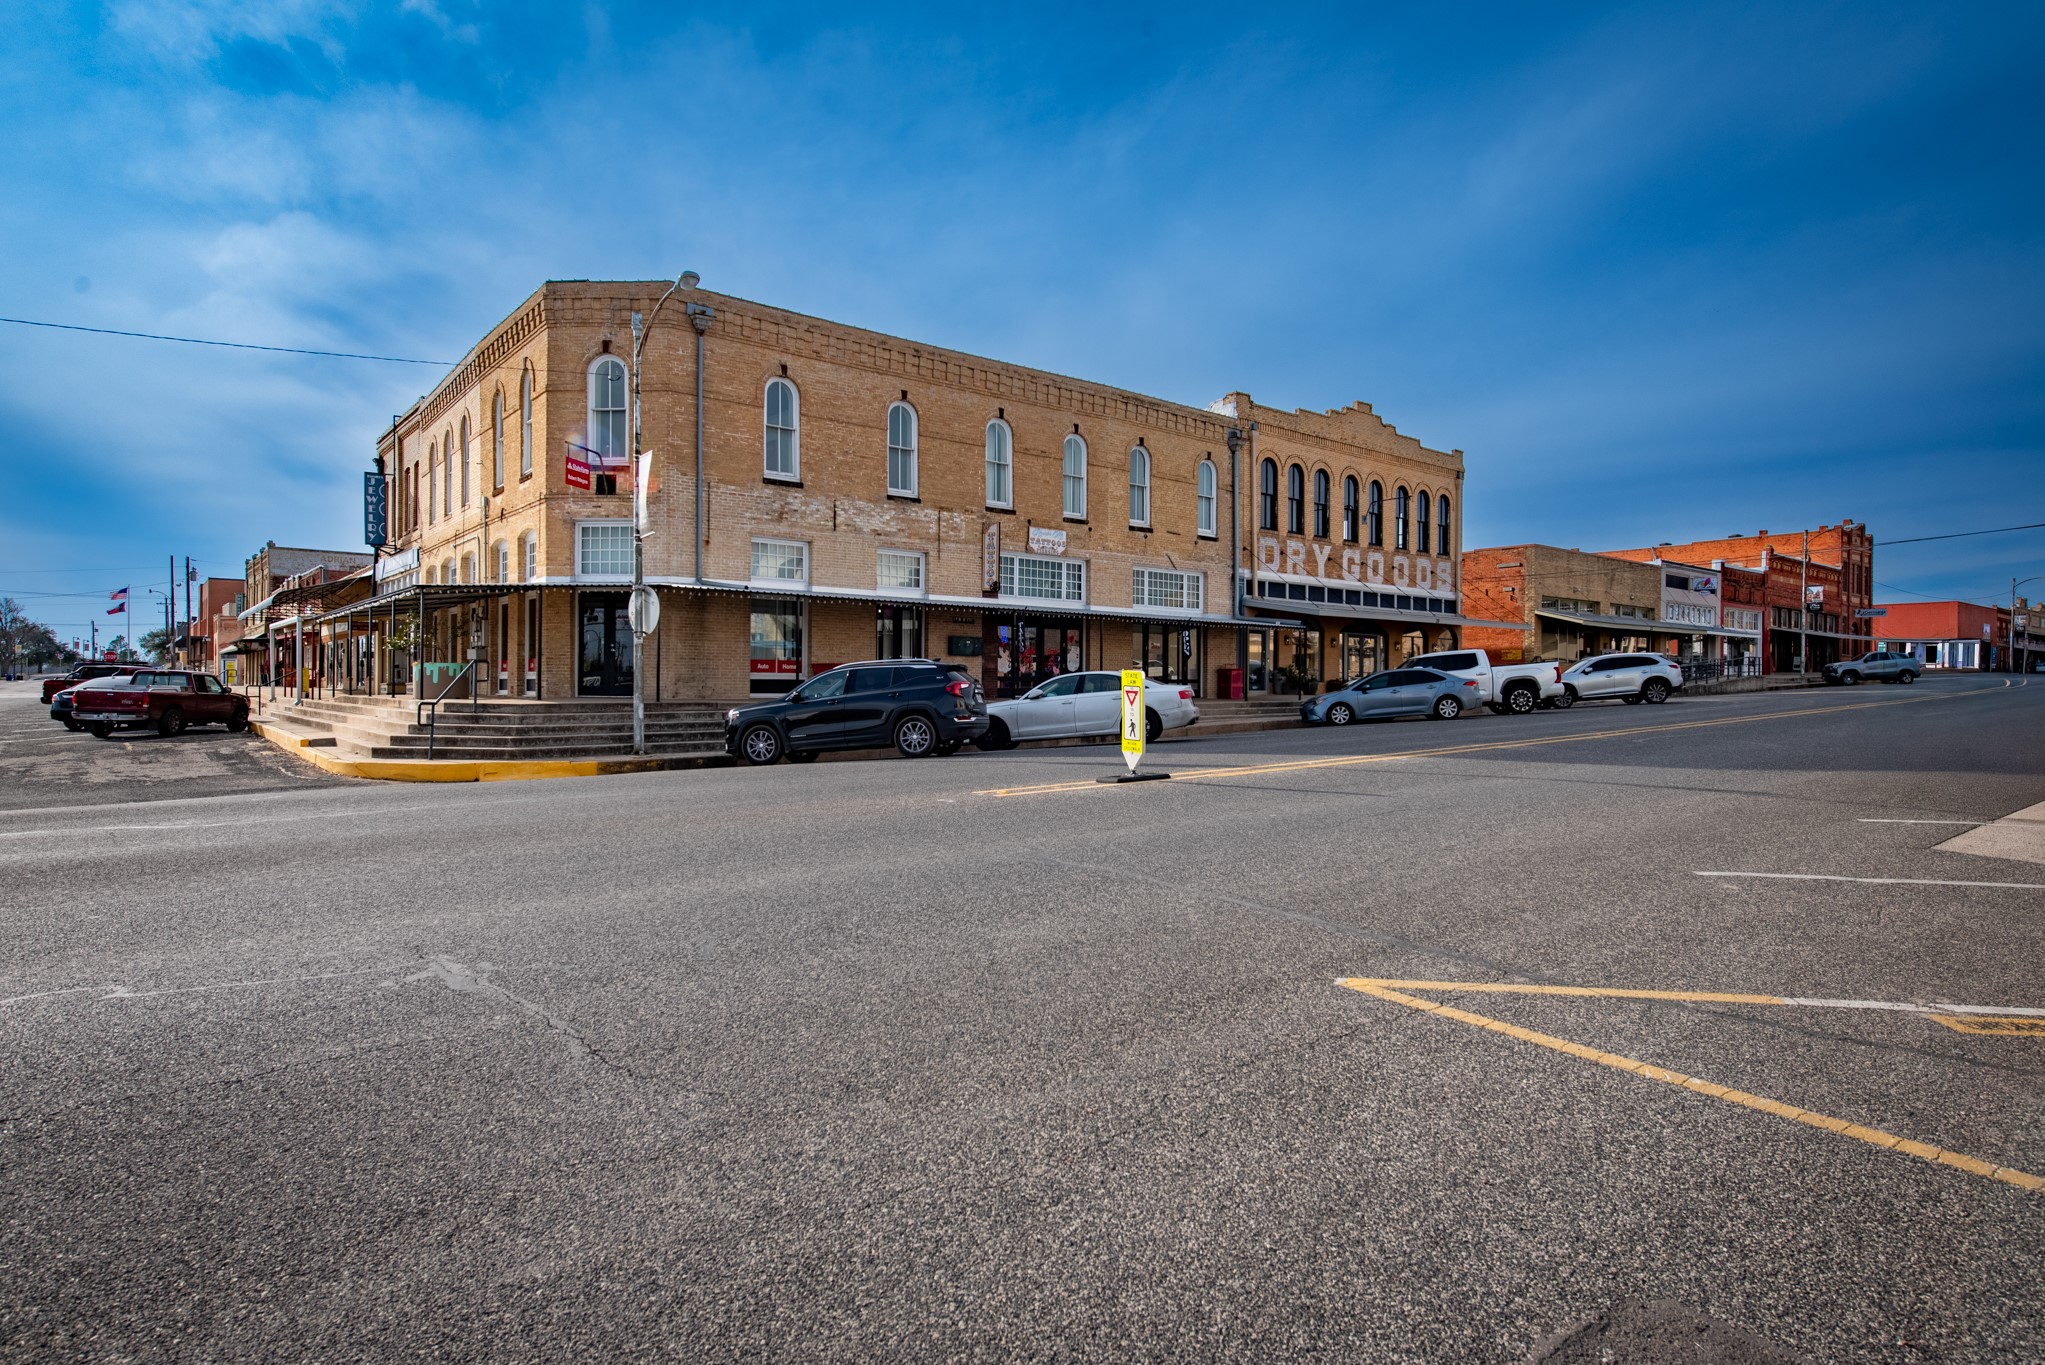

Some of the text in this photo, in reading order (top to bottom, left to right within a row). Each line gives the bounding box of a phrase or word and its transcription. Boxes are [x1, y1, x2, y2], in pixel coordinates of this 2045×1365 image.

[366, 477, 379, 542] JEWELRY
[1030, 536, 1066, 548] TATTOOS
[319, 555, 356, 565] ADRIAN
[1258, 536, 1452, 592] DRY GOODS
